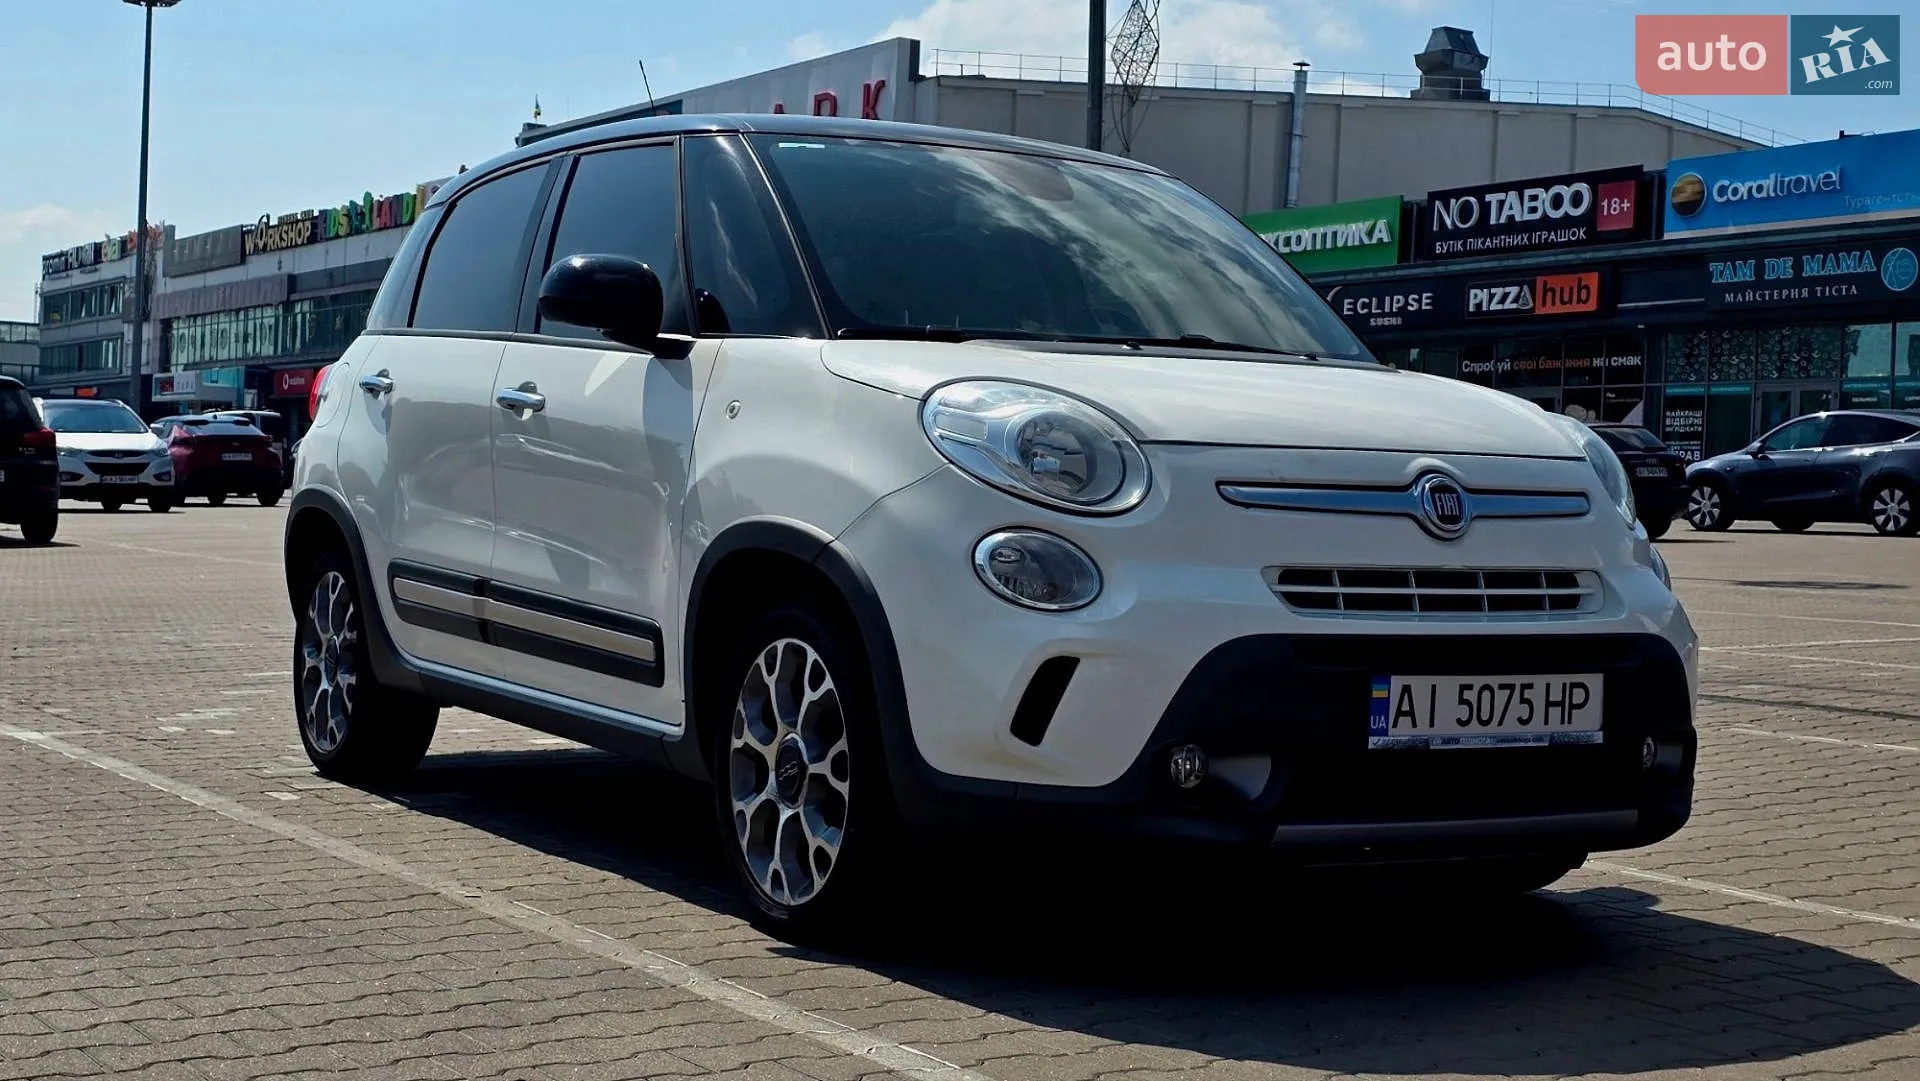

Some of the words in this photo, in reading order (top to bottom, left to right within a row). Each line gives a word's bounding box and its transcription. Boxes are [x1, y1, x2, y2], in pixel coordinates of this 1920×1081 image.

[1713, 165, 1842, 203] Coraltravel
[1433, 196, 1480, 231] NO
[1485, 182, 1593, 225] TABOO
[1600, 198, 1631, 216] 18+
[245, 219, 312, 255] WORKSHOP
[1435, 239, 1464, 254] БУТІК
[1466, 233, 1529, 251] ПІКАНТНИХ
[1531, 227, 1587, 245] ІГРАШОК
[1763, 256, 1794, 280] DE
[1802, 250, 1877, 277] MAMA
[1343, 292, 1434, 316] ECLIPSE
[1541, 276, 1592, 309] hub
[1724, 286, 1809, 304] МАЙСТЕРНЯ
[1814, 284, 1859, 298] ТІСТА
[1611, 355, 1642, 367] смак
[1434, 492, 1460, 516] FIAT
[1455, 683, 1535, 728] 5075
[1543, 681, 1591, 726] HP
[1370, 715, 1387, 730] UA
